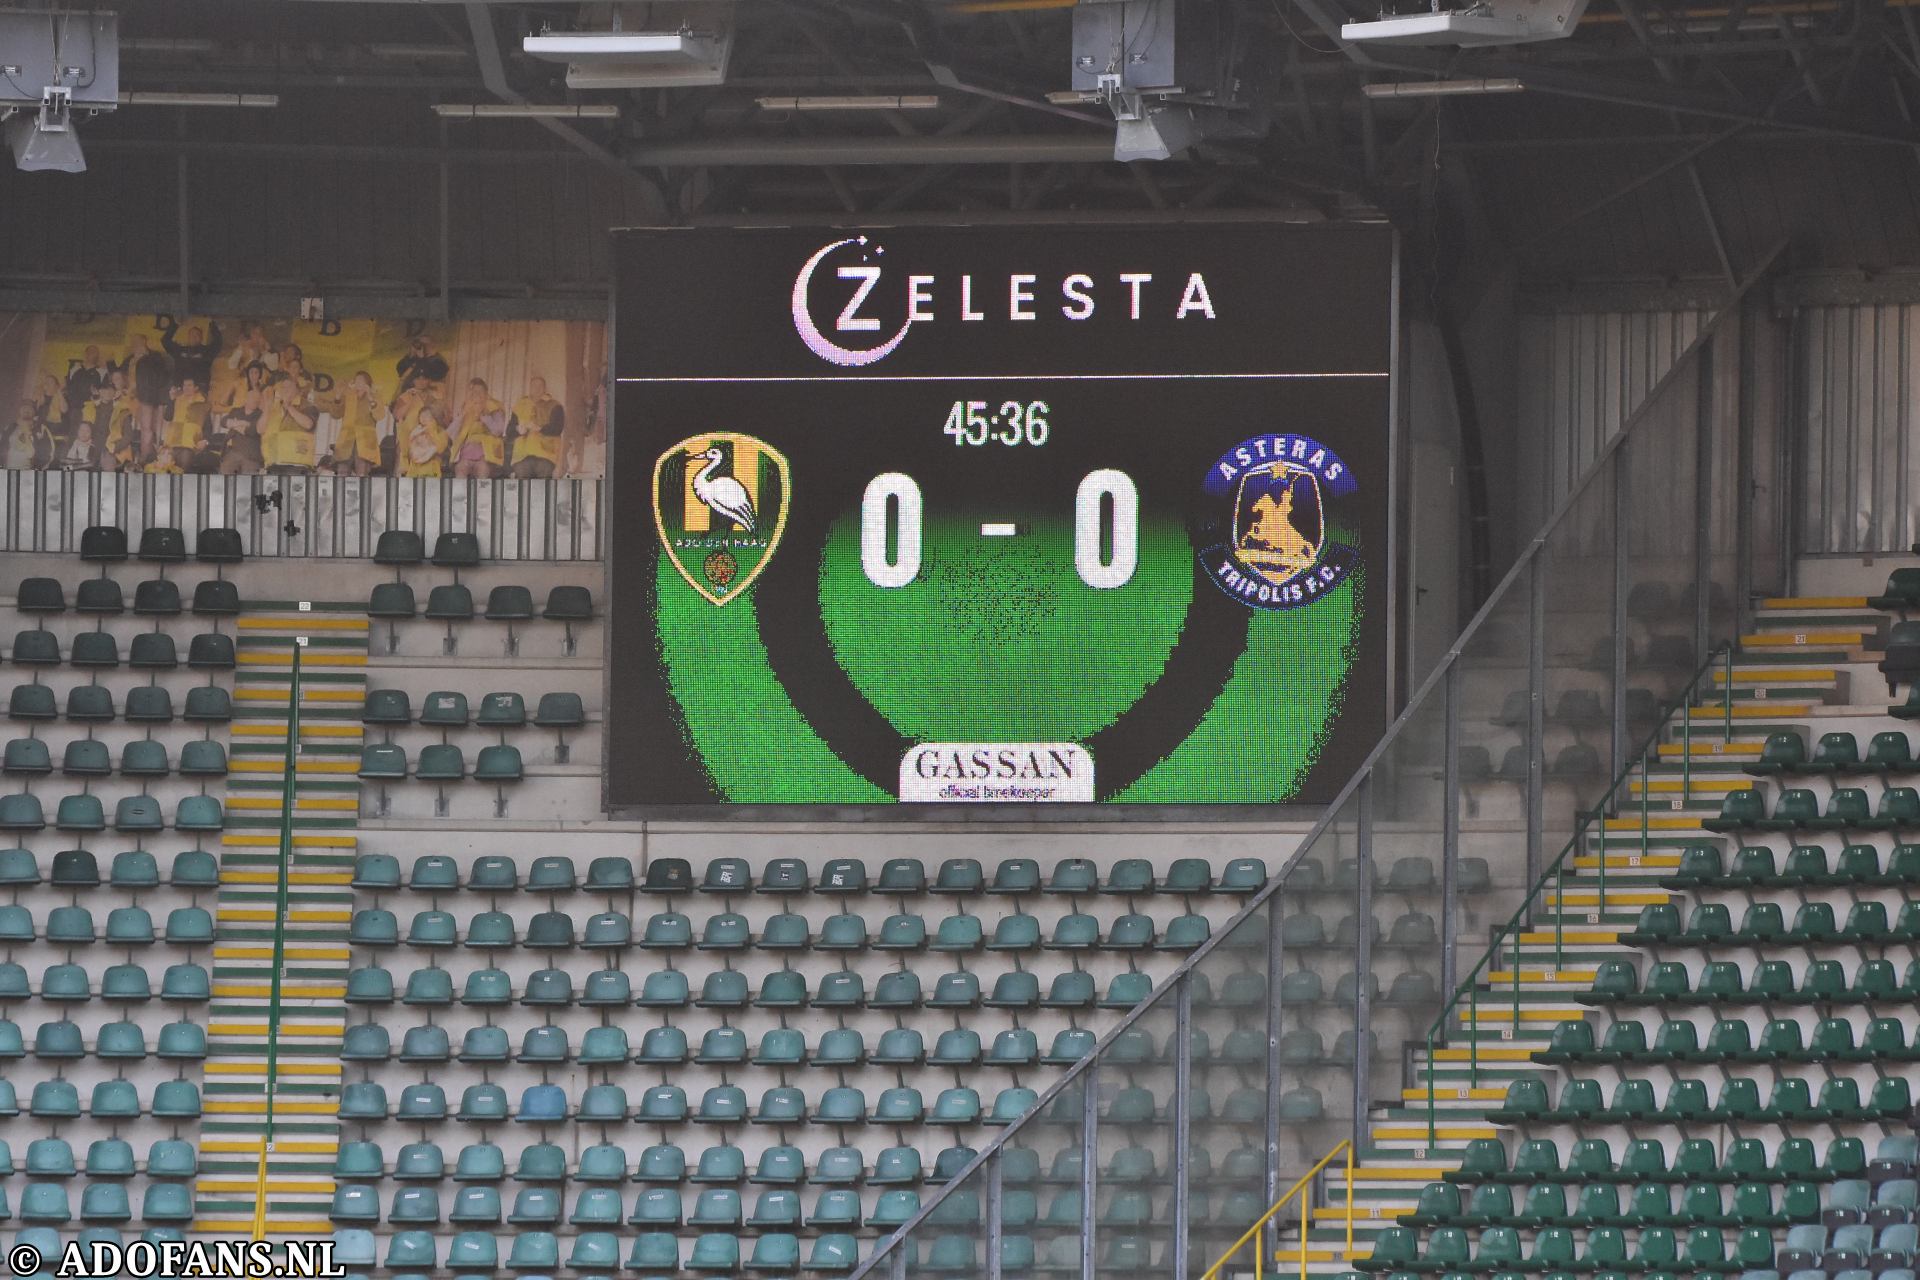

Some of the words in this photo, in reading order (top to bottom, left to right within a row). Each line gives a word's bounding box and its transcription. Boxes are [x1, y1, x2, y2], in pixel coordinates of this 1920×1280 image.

[836, 266, 1216, 331] ZELESTA
[943, 400, 1050, 447] 45:36
[1219, 437, 1343, 481] ASTERAS
[861, 472, 923, 588] 0
[1075, 469, 1138, 589] 0
[1218, 560, 1303, 602] TRIPOLIS
[916, 749, 1075, 779] GASSAN
